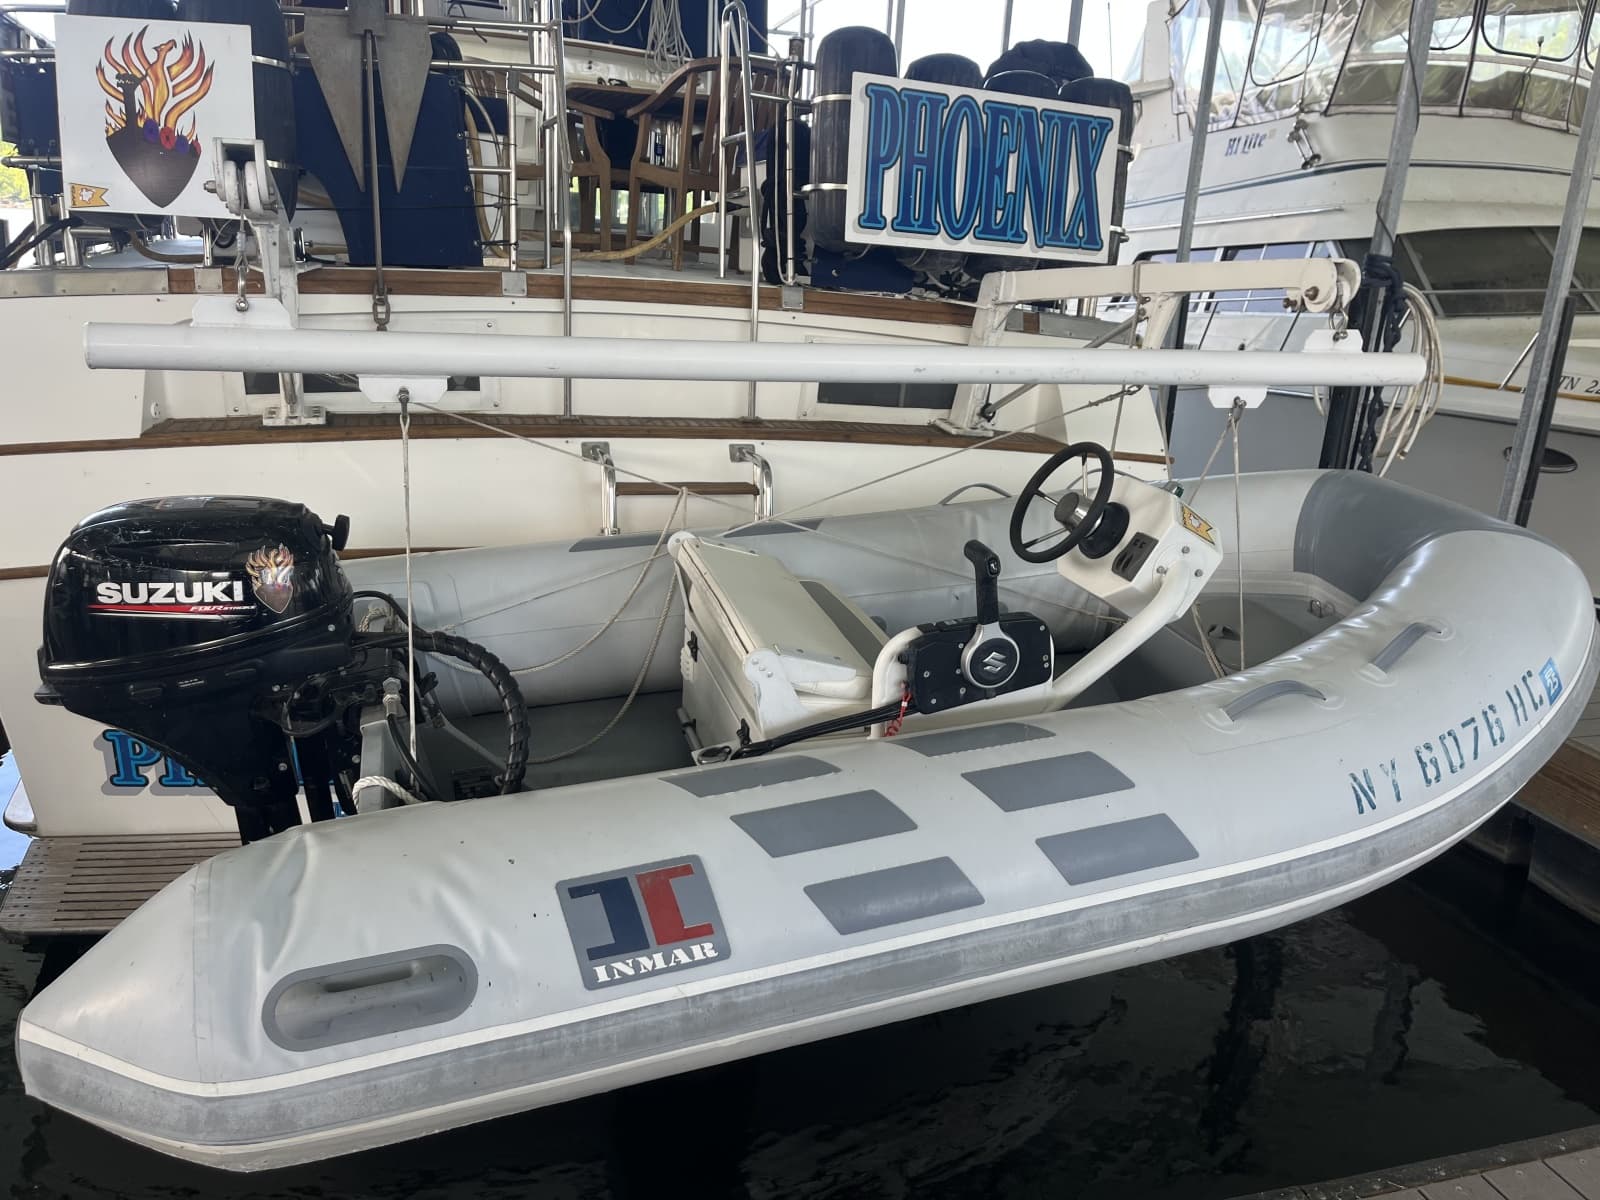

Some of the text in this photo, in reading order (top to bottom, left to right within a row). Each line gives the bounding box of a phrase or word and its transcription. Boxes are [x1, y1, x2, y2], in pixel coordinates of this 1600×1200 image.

[858, 83, 1113, 251] PHOENIX
[1558, 375, 1581, 391] TN
[96, 580, 244, 605] SUZUKI
[1414, 703, 1506, 788] 6076
[1505, 669, 1545, 727] HC
[593, 942, 719, 983] INMAR
